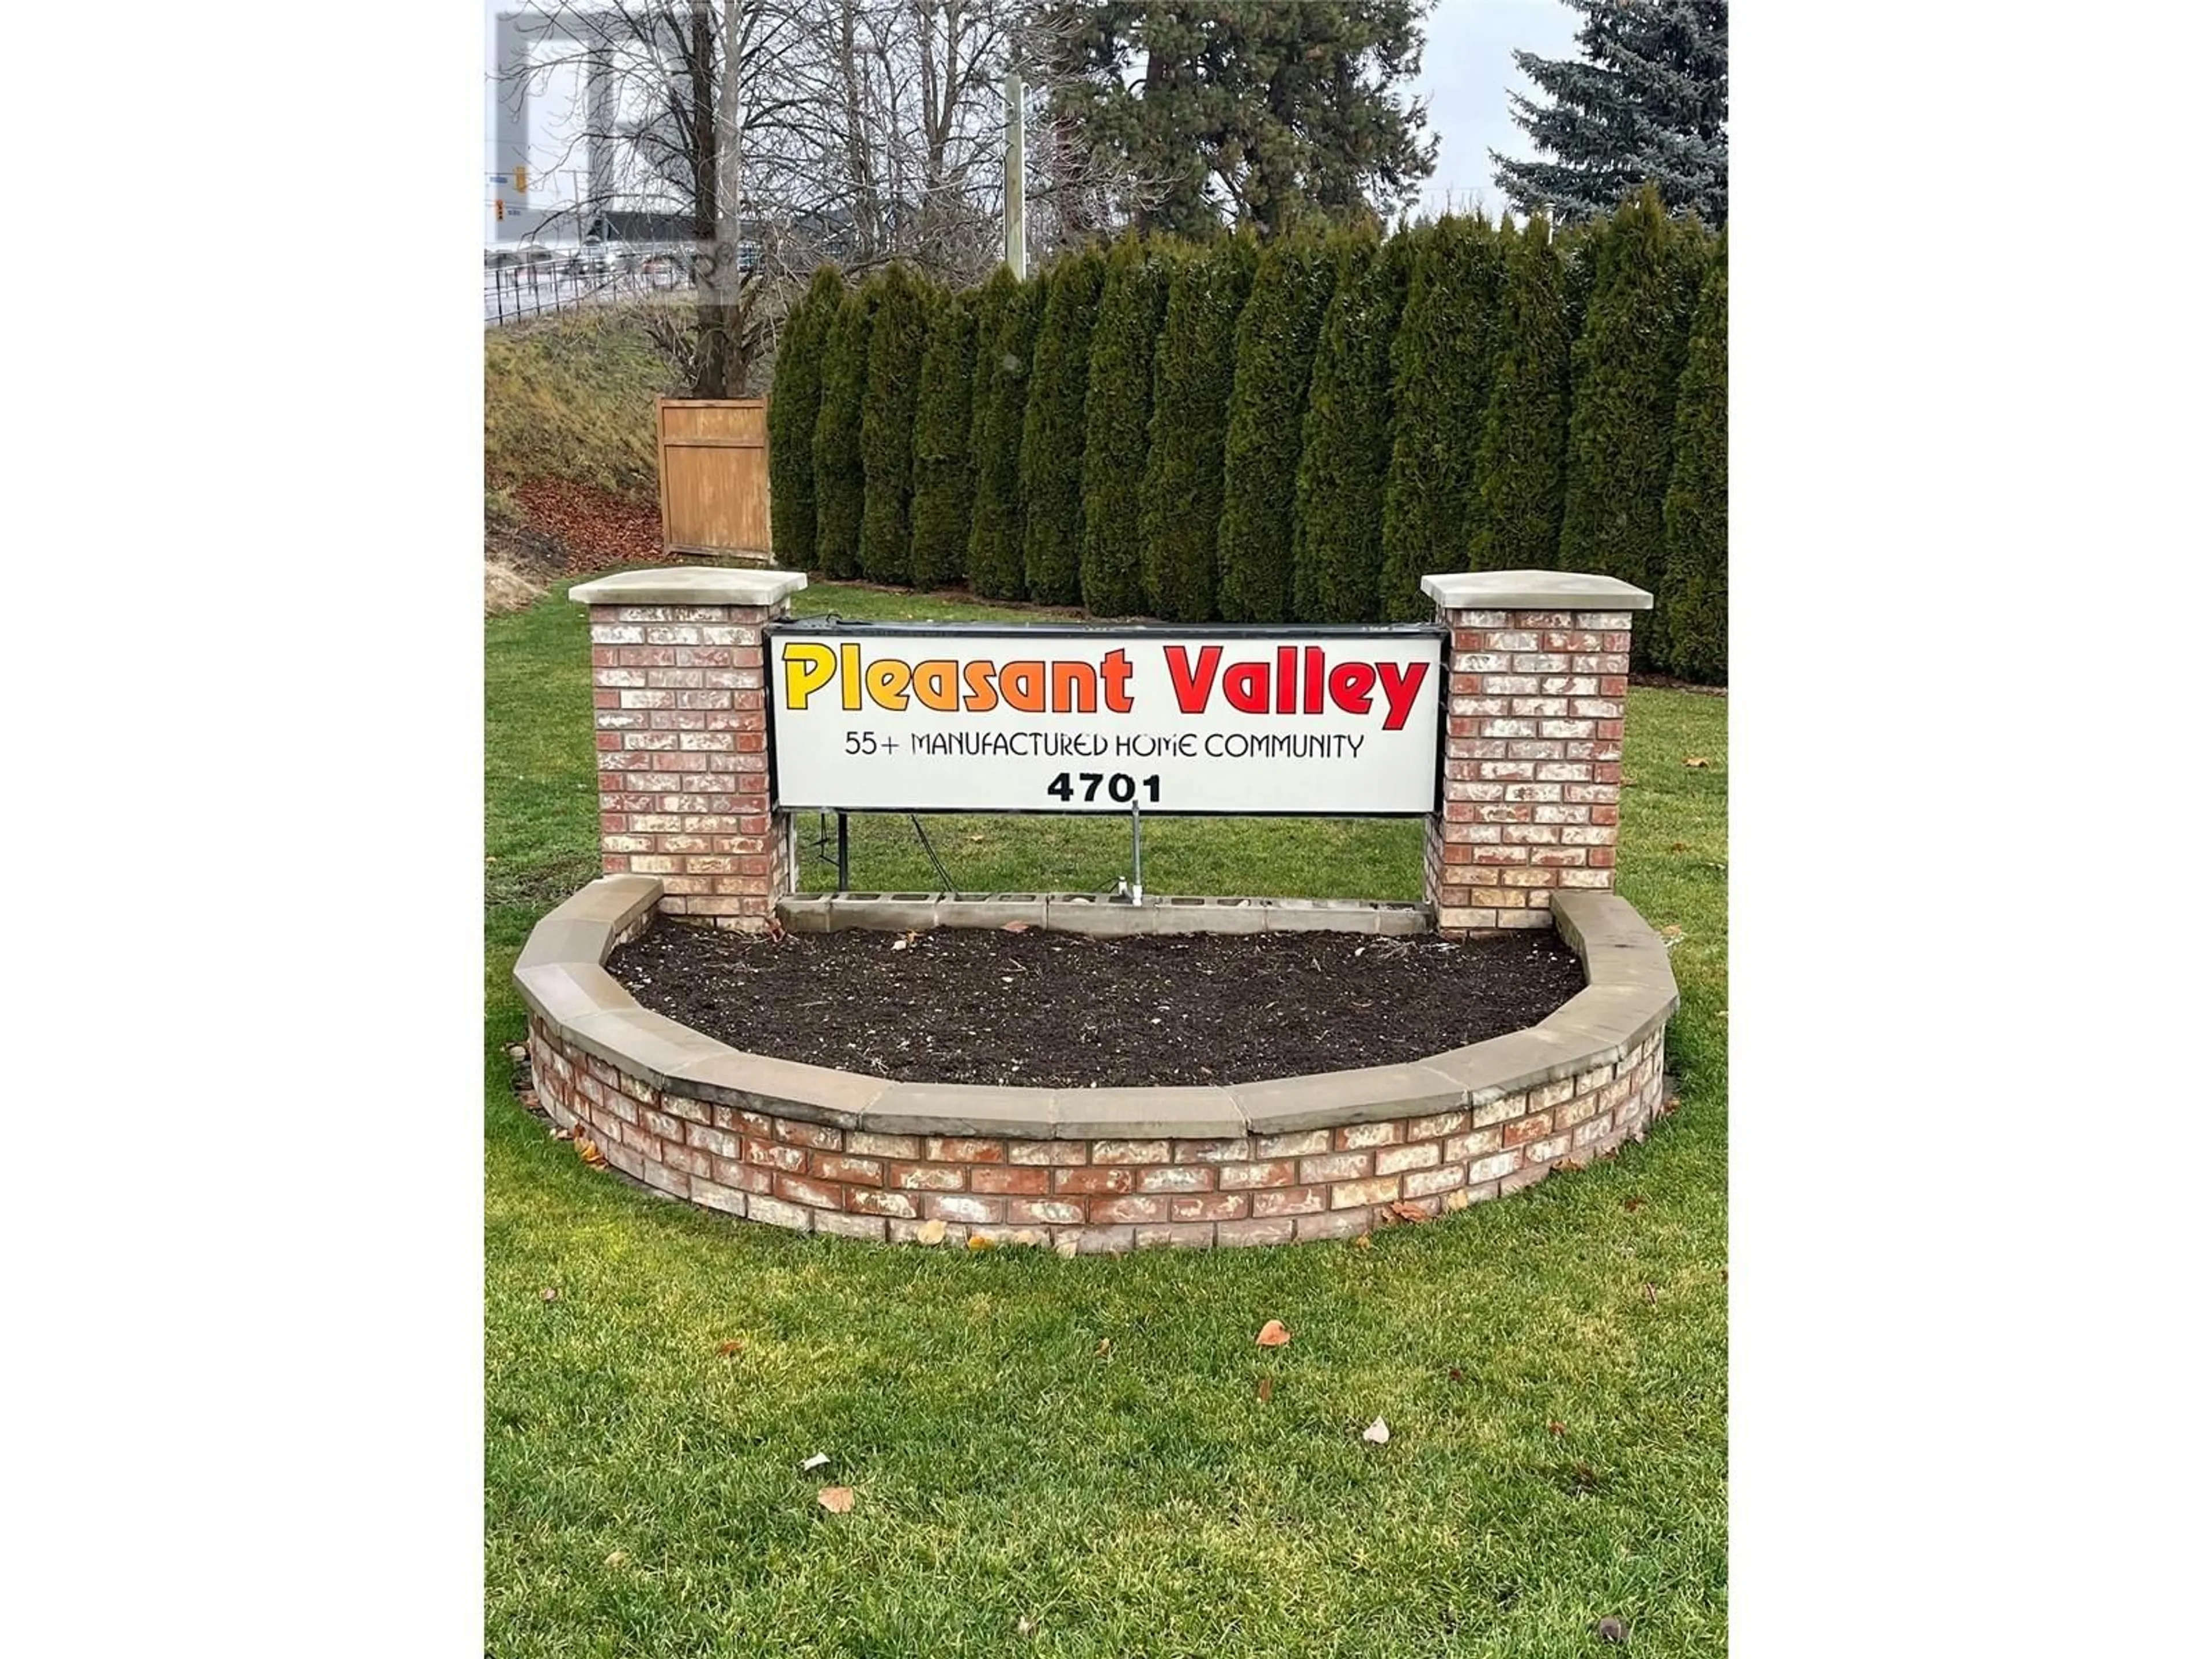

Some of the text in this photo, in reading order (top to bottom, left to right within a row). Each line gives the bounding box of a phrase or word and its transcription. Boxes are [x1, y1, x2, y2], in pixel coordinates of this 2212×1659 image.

[782, 642, 1430, 730] Pleasant Valley
[844, 731, 1364, 758] 55+ MANUFACTURED HOME COMMUNITY
[1047, 772, 1160, 803] 4701
